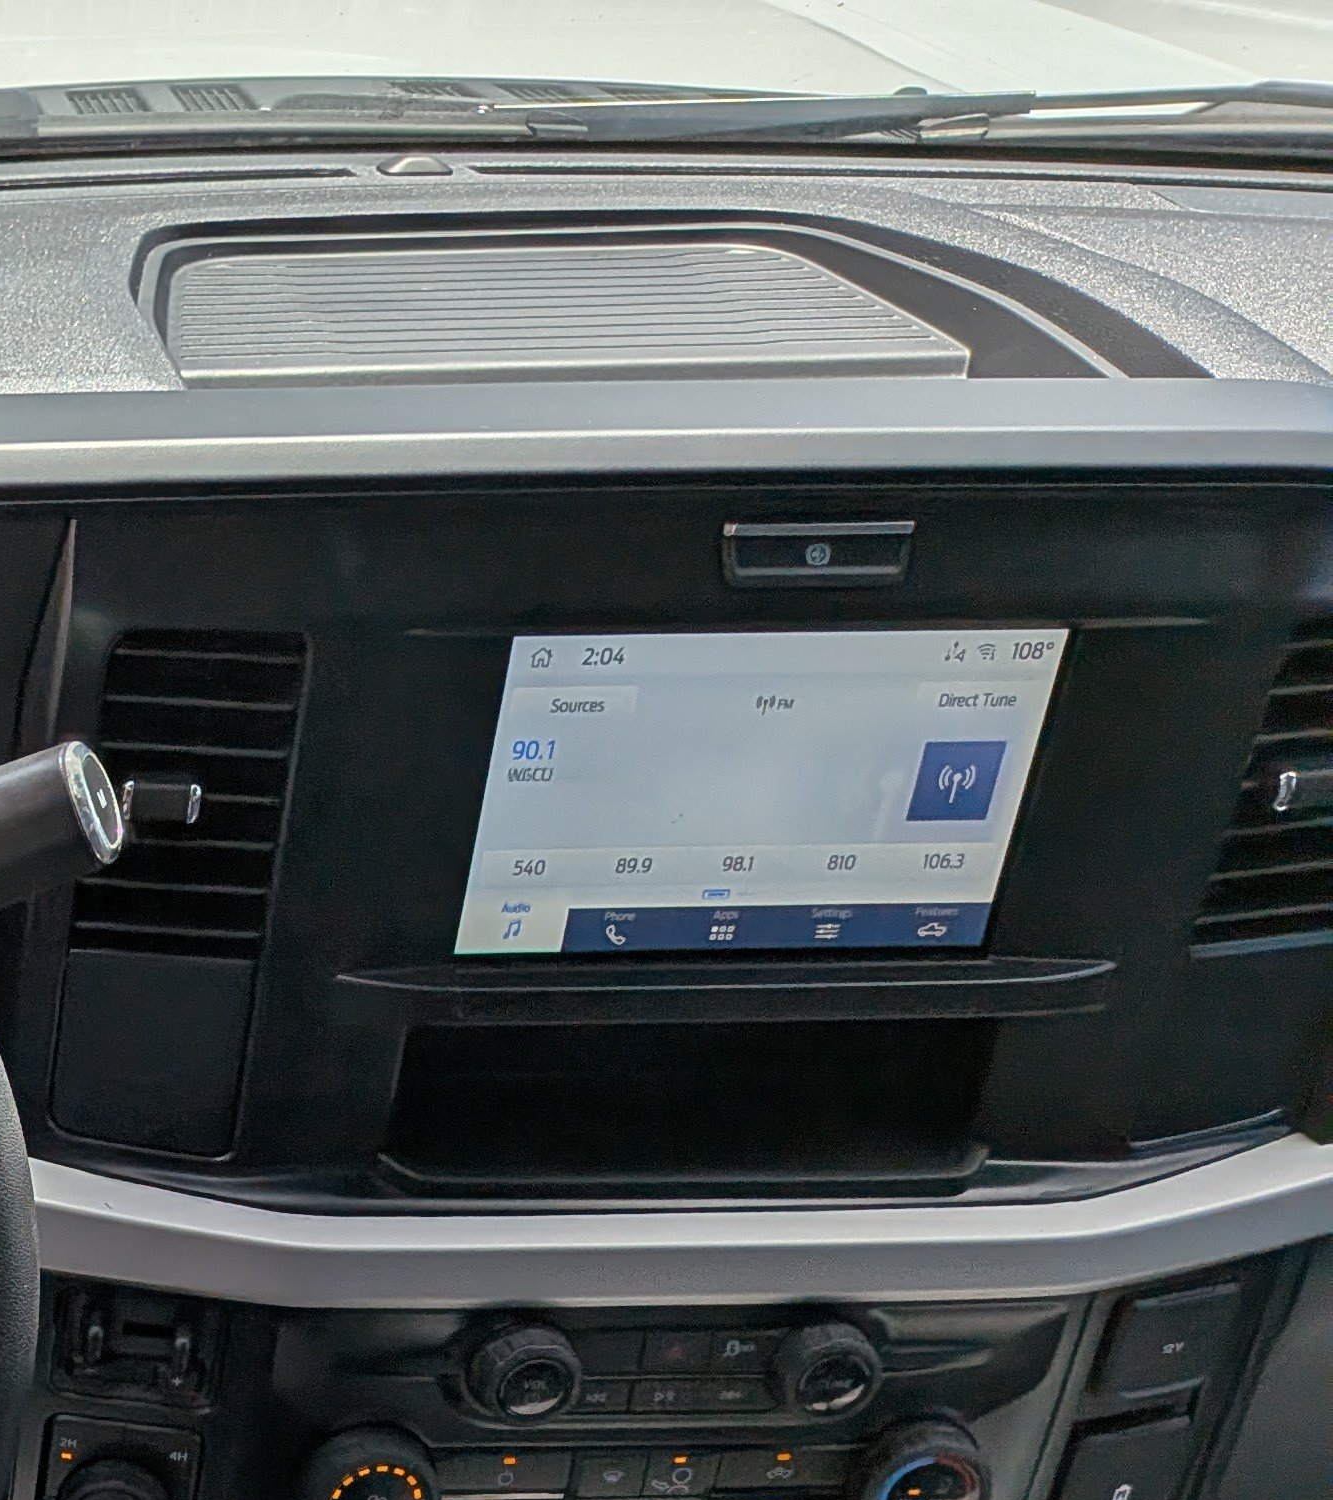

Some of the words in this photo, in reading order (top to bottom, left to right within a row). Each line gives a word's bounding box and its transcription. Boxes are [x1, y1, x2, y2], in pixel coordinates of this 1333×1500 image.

[581, 646, 625, 666] 2:04
[549, 698, 606, 714] Sources
[938, 692, 979, 708] Direct
[983, 692, 1018, 708] Tune
[511, 739, 557, 761] 90.1
[511, 858, 547, 877] 540
[614, 856, 653, 875] 89.9
[721, 855, 755, 873] 98.1
[826, 853, 857, 872] 810
[922, 852, 965, 871] 106.3
[500, 902, 532, 914] Audio
[712, 909, 739, 922] Apps
[58, 1437, 78, 1449] 2H
[168, 1451, 189, 1463] 4H
